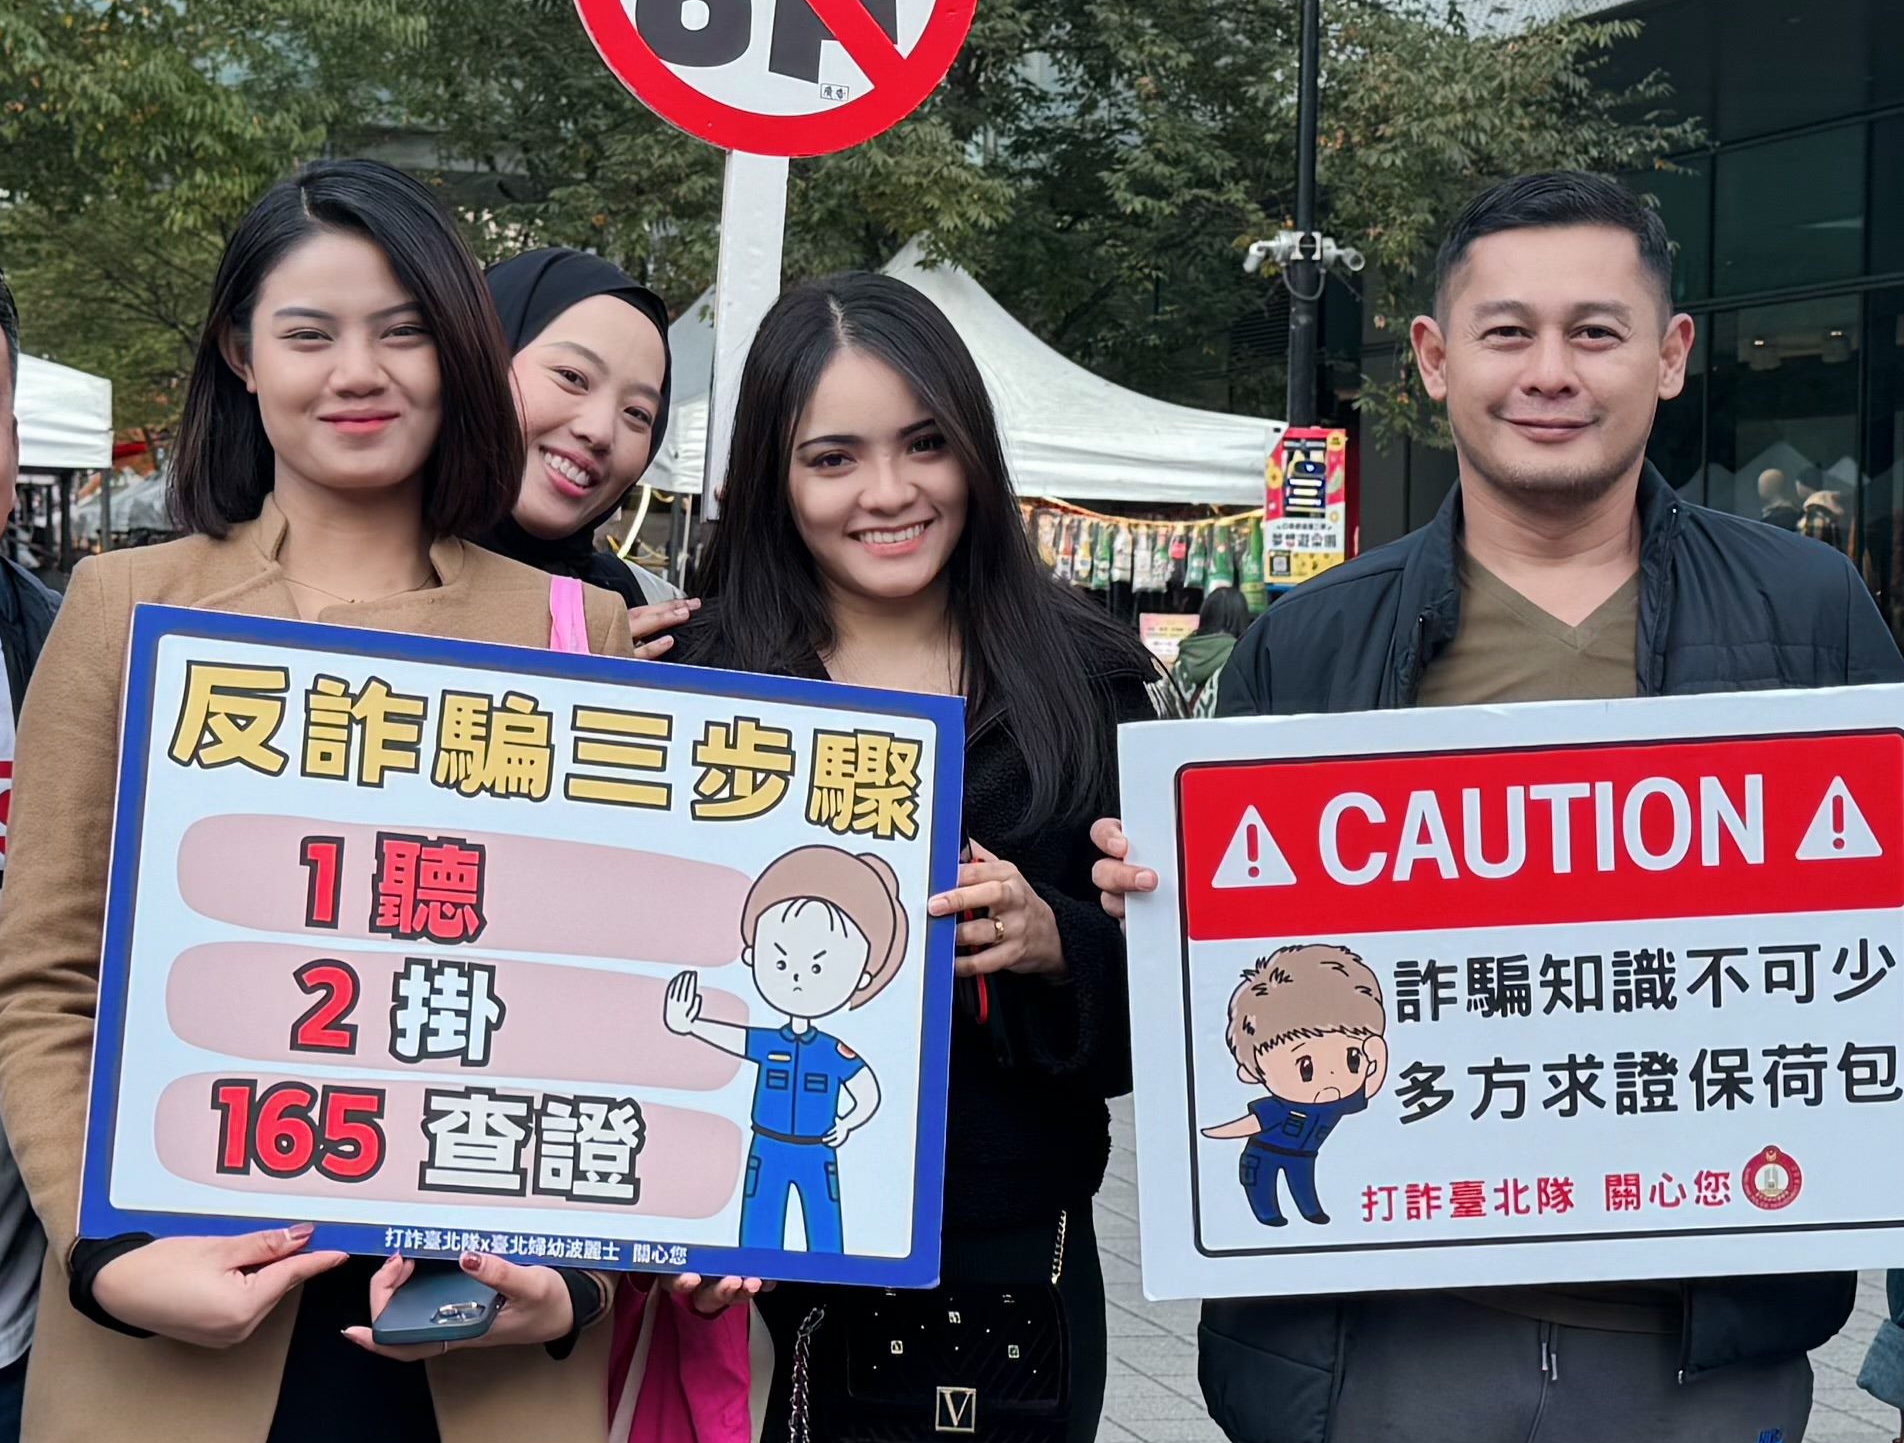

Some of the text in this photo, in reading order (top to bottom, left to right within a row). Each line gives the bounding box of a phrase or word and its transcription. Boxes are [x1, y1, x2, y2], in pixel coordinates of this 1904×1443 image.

[168, 661, 925, 840] 反詐騙三步驟
[1318, 773, 1765, 887] CAUTION
[300, 833, 488, 945] 1 聽
[291, 959, 505, 1067] 2 掛
[1393, 937, 1897, 1023] 詐騙知識不可少
[1393, 1042, 1904, 1125] 多方求證保荷包
[211, 1078, 645, 1204] 165 查證
[1360, 1173, 1576, 1223] 打詐臺北隊
[1604, 1169, 1732, 1212] 關心您
[632, 1243, 687, 1266] 關心您
